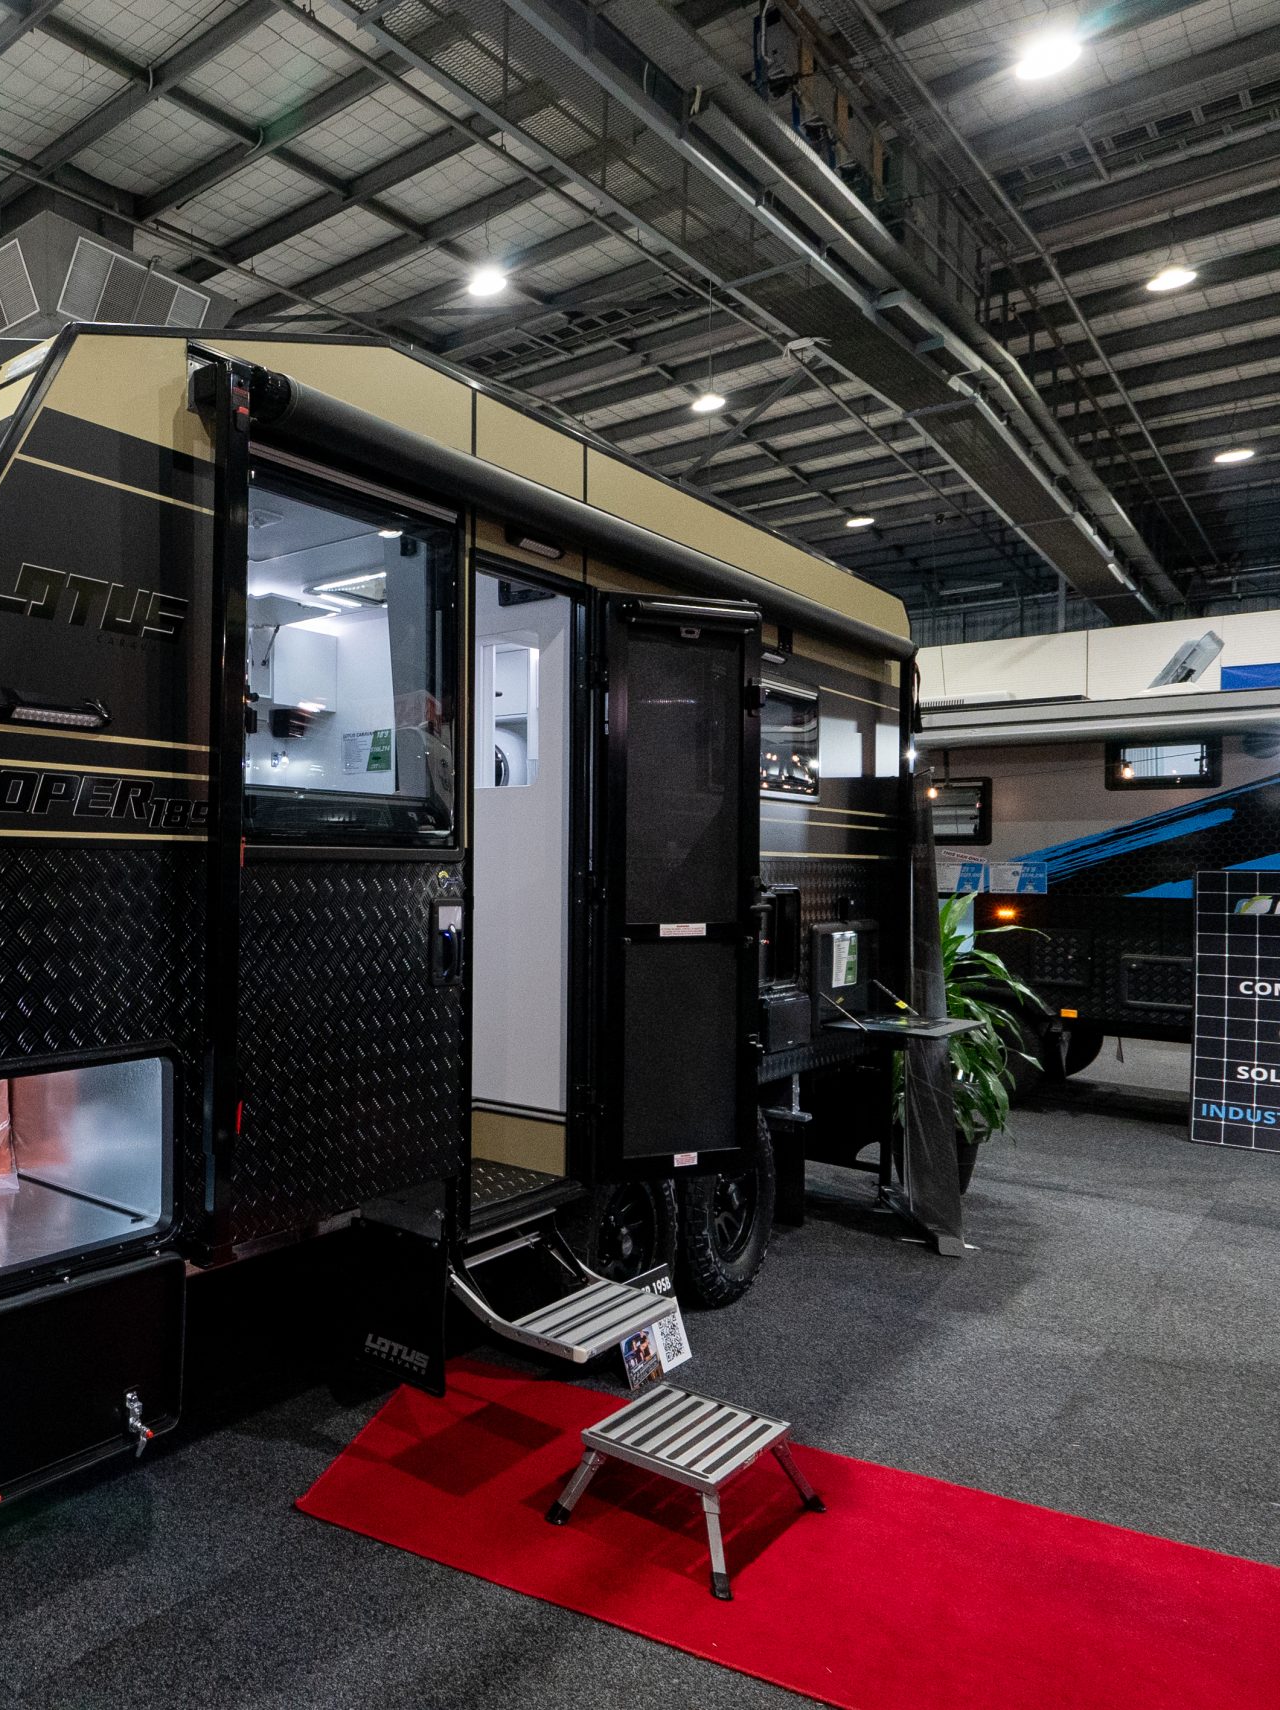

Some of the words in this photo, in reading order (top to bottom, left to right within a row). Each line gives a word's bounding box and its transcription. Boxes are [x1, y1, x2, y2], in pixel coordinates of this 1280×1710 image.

[1201, 1103, 1280, 1125] INDUS
[364, 1333, 430, 1369] LOTUS
[364, 1346, 426, 1376] CARAVANS
